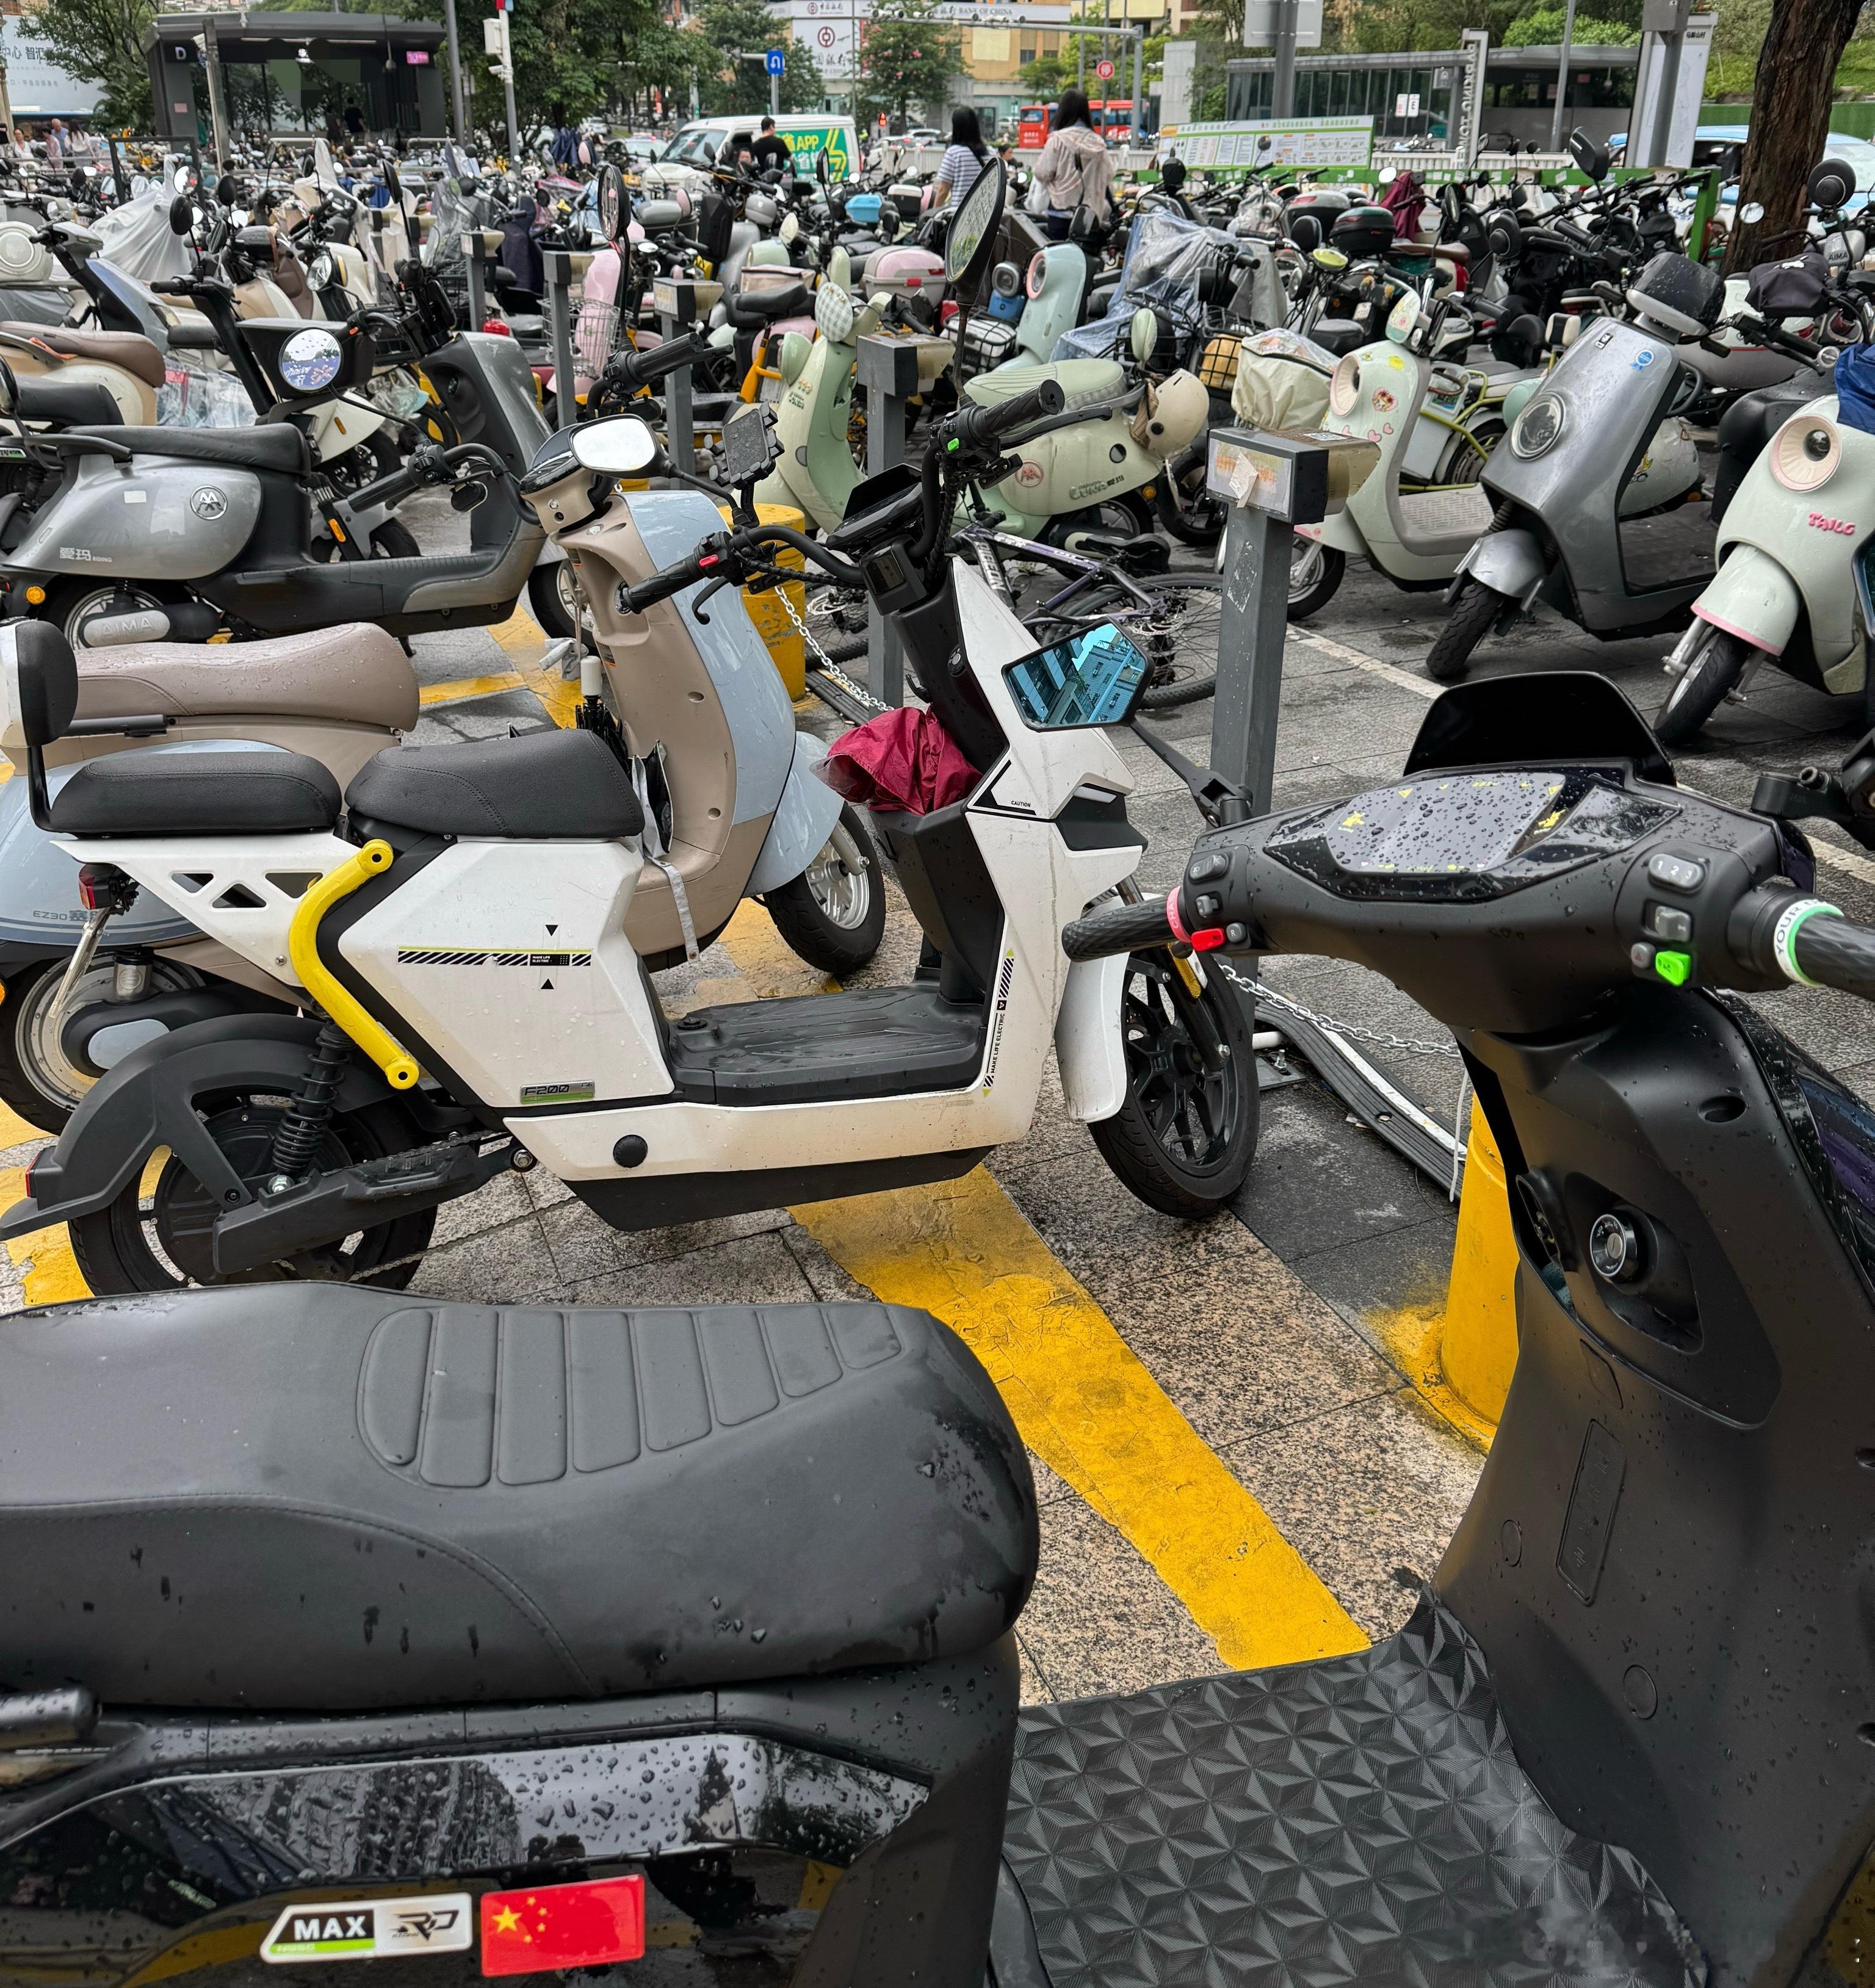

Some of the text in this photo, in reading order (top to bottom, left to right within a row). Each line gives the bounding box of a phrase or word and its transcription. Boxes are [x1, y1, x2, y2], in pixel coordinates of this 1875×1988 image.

[175, 46, 187, 60] D
[1829, 252, 1848, 261] AIMA
[59, 547, 91, 561] 爱玛
[99, 617, 156, 636] AIMA
[1657, 860, 1693, 879] 1 2 3
[33, 910, 68, 921] EZ30
[1776, 906, 1802, 955] YOUR
[996, 1014, 1005, 1041] ELECTRIC
[525, 1085, 569, 1096] F200
[294, 1915, 367, 1941] MAX
